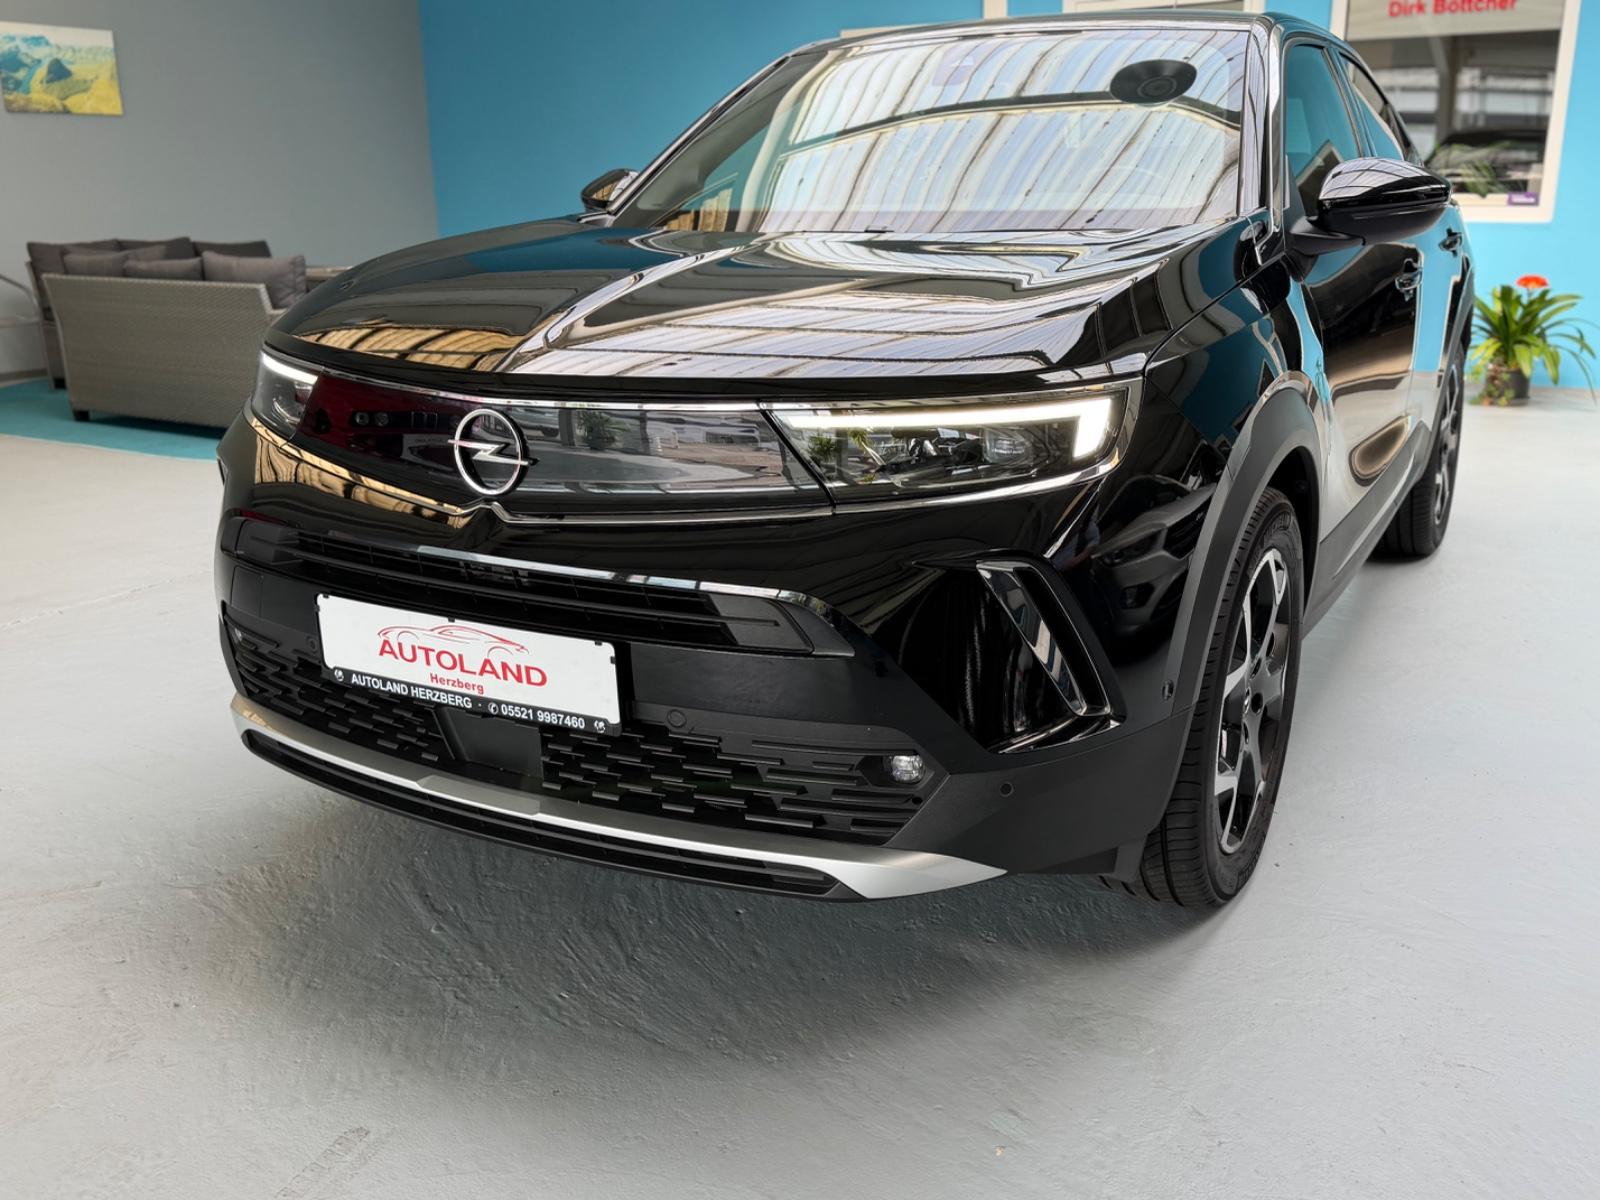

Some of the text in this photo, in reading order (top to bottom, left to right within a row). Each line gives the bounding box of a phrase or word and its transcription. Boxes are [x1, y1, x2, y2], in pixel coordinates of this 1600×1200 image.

[378, 639, 548, 687] AUTOLAND
[429, 672, 485, 695] Herzberg
[351, 673, 586, 730] AUTOLAND HERZBERG 05521 9987460
